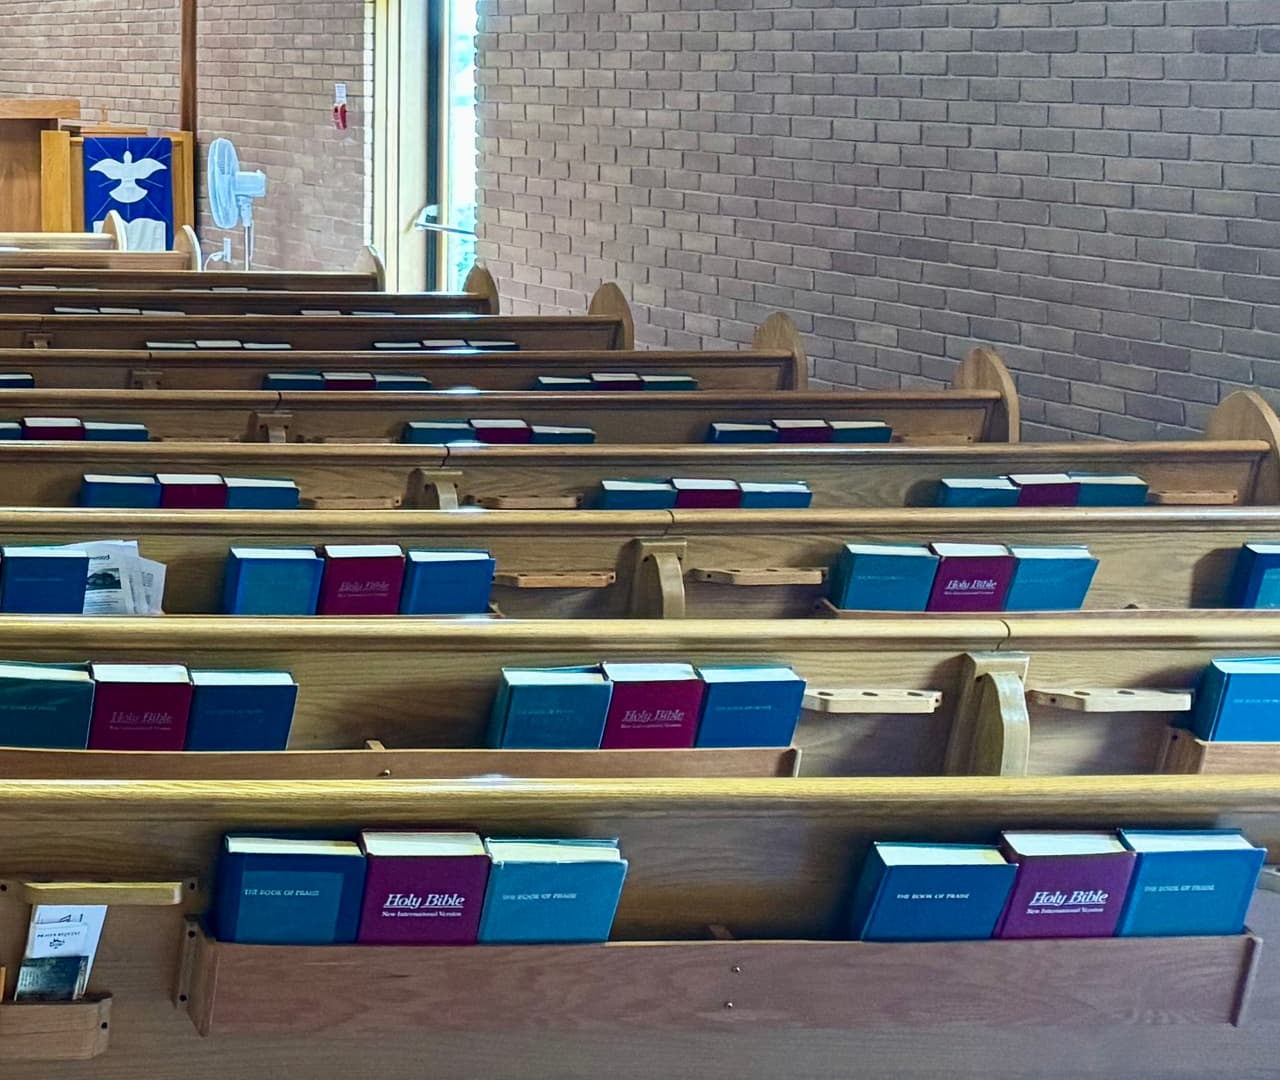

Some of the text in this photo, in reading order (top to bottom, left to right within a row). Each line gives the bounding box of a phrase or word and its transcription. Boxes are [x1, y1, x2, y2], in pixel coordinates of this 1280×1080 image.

[384, 894, 465, 909] Holy Bible
[1030, 890, 1108, 906] Holy Bible
